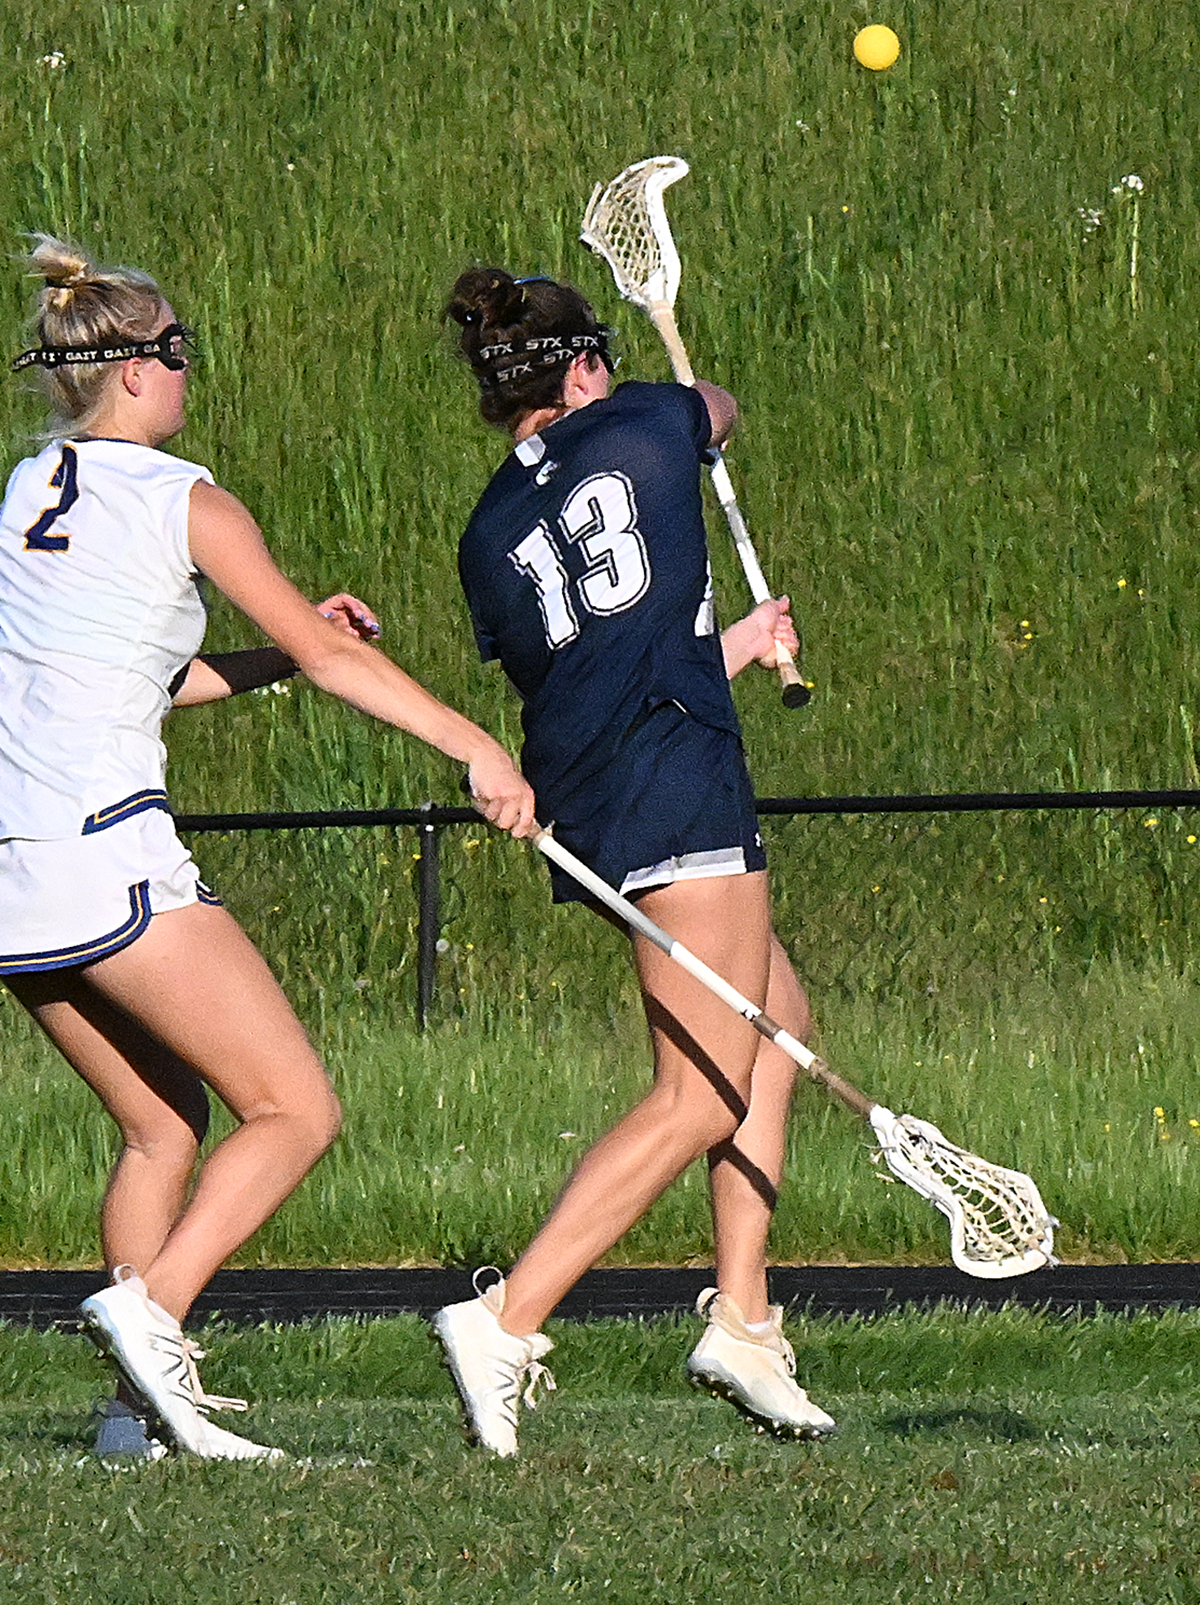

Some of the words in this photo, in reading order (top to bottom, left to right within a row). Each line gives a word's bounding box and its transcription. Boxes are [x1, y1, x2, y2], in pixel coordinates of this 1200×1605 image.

[65, 350, 98, 361] GAIT
[103, 345, 138, 359] GAIT
[525, 336, 562, 351] STX
[571, 336, 599, 347] STX
[496, 361, 533, 383] STX
[23, 443, 80, 554] 2
[507, 470, 651, 650] 13
